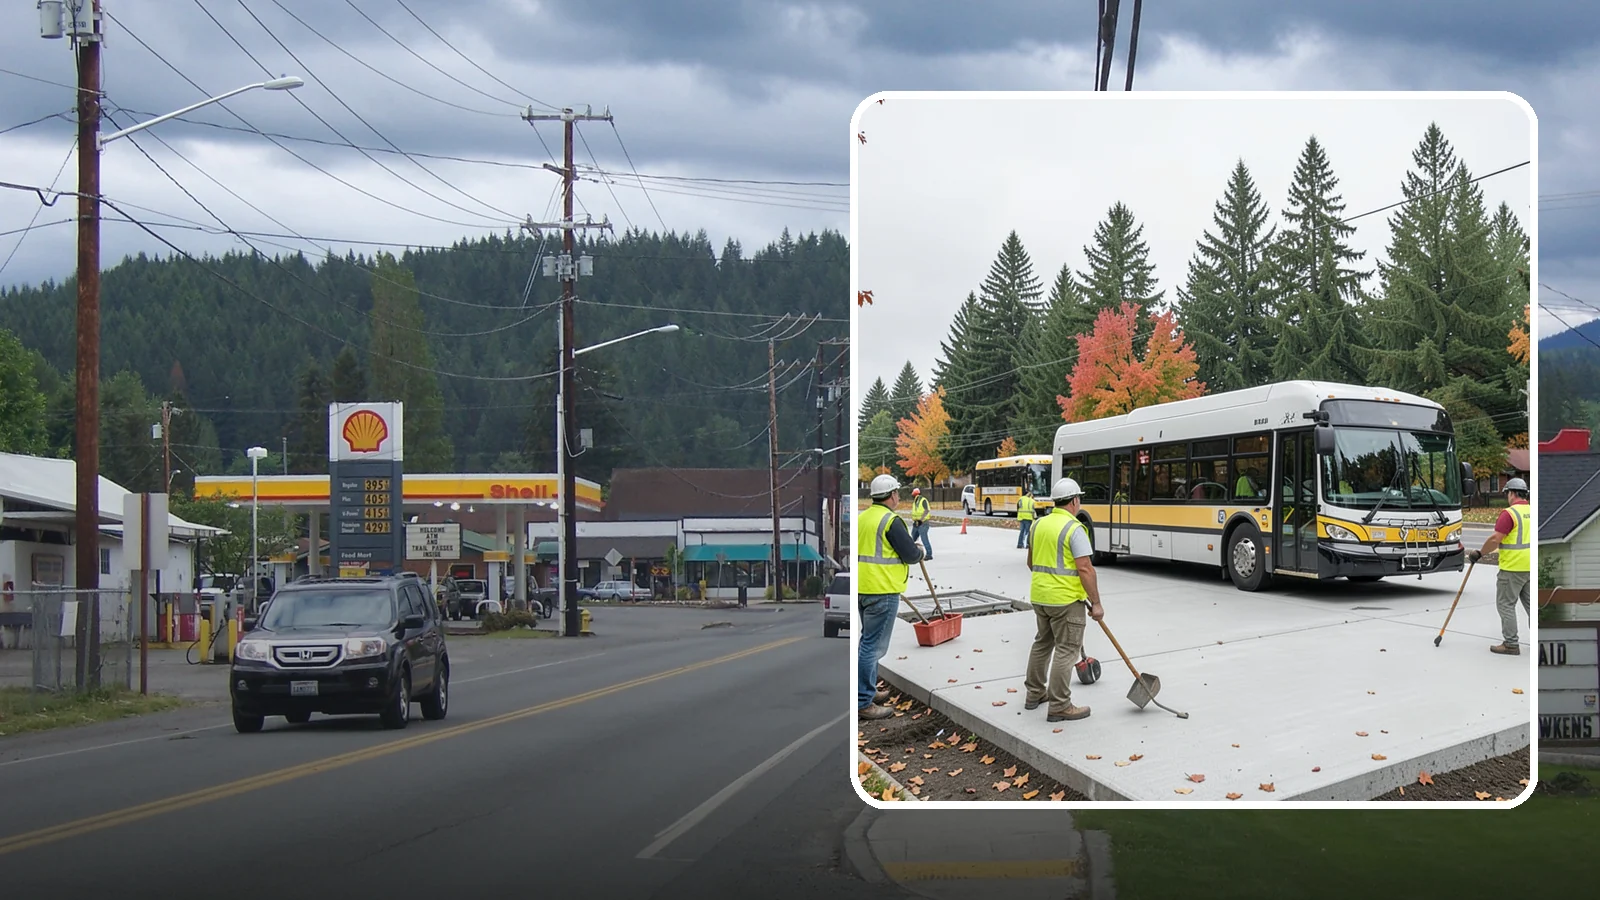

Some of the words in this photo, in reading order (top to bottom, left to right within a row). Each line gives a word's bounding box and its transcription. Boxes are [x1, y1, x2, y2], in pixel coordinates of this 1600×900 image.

[365, 480, 383, 490] 395
[490, 484, 547, 499] Shell
[365, 494, 383, 504] 405
[365, 508, 383, 518] 415
[366, 522, 383, 533] 429
